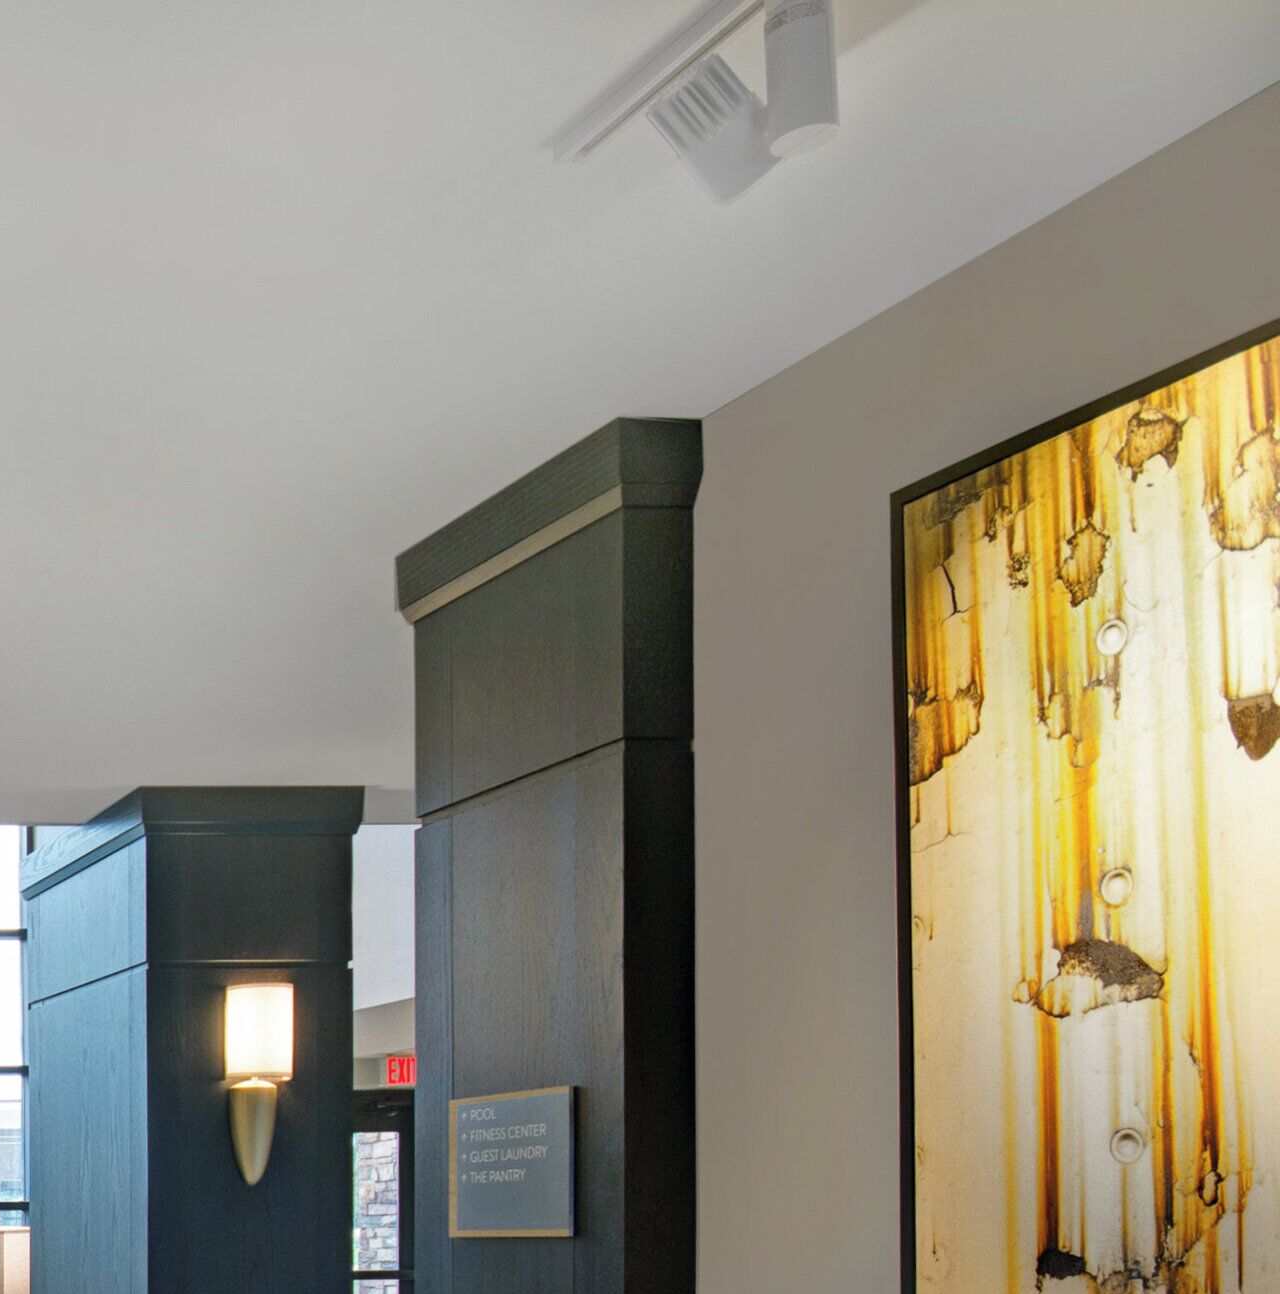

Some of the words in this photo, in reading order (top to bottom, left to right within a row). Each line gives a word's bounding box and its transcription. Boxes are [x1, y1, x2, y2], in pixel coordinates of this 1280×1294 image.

[470, 1107, 497, 1121] POOL
[470, 1127, 506, 1142] FITNESS
[507, 1123, 547, 1139] CENTER
[470, 1148, 499, 1163] GUEST
[500, 1145, 549, 1161] LAUNDRY
[470, 1170, 488, 1183] THE
[489, 1167, 528, 1182] PANTRY
